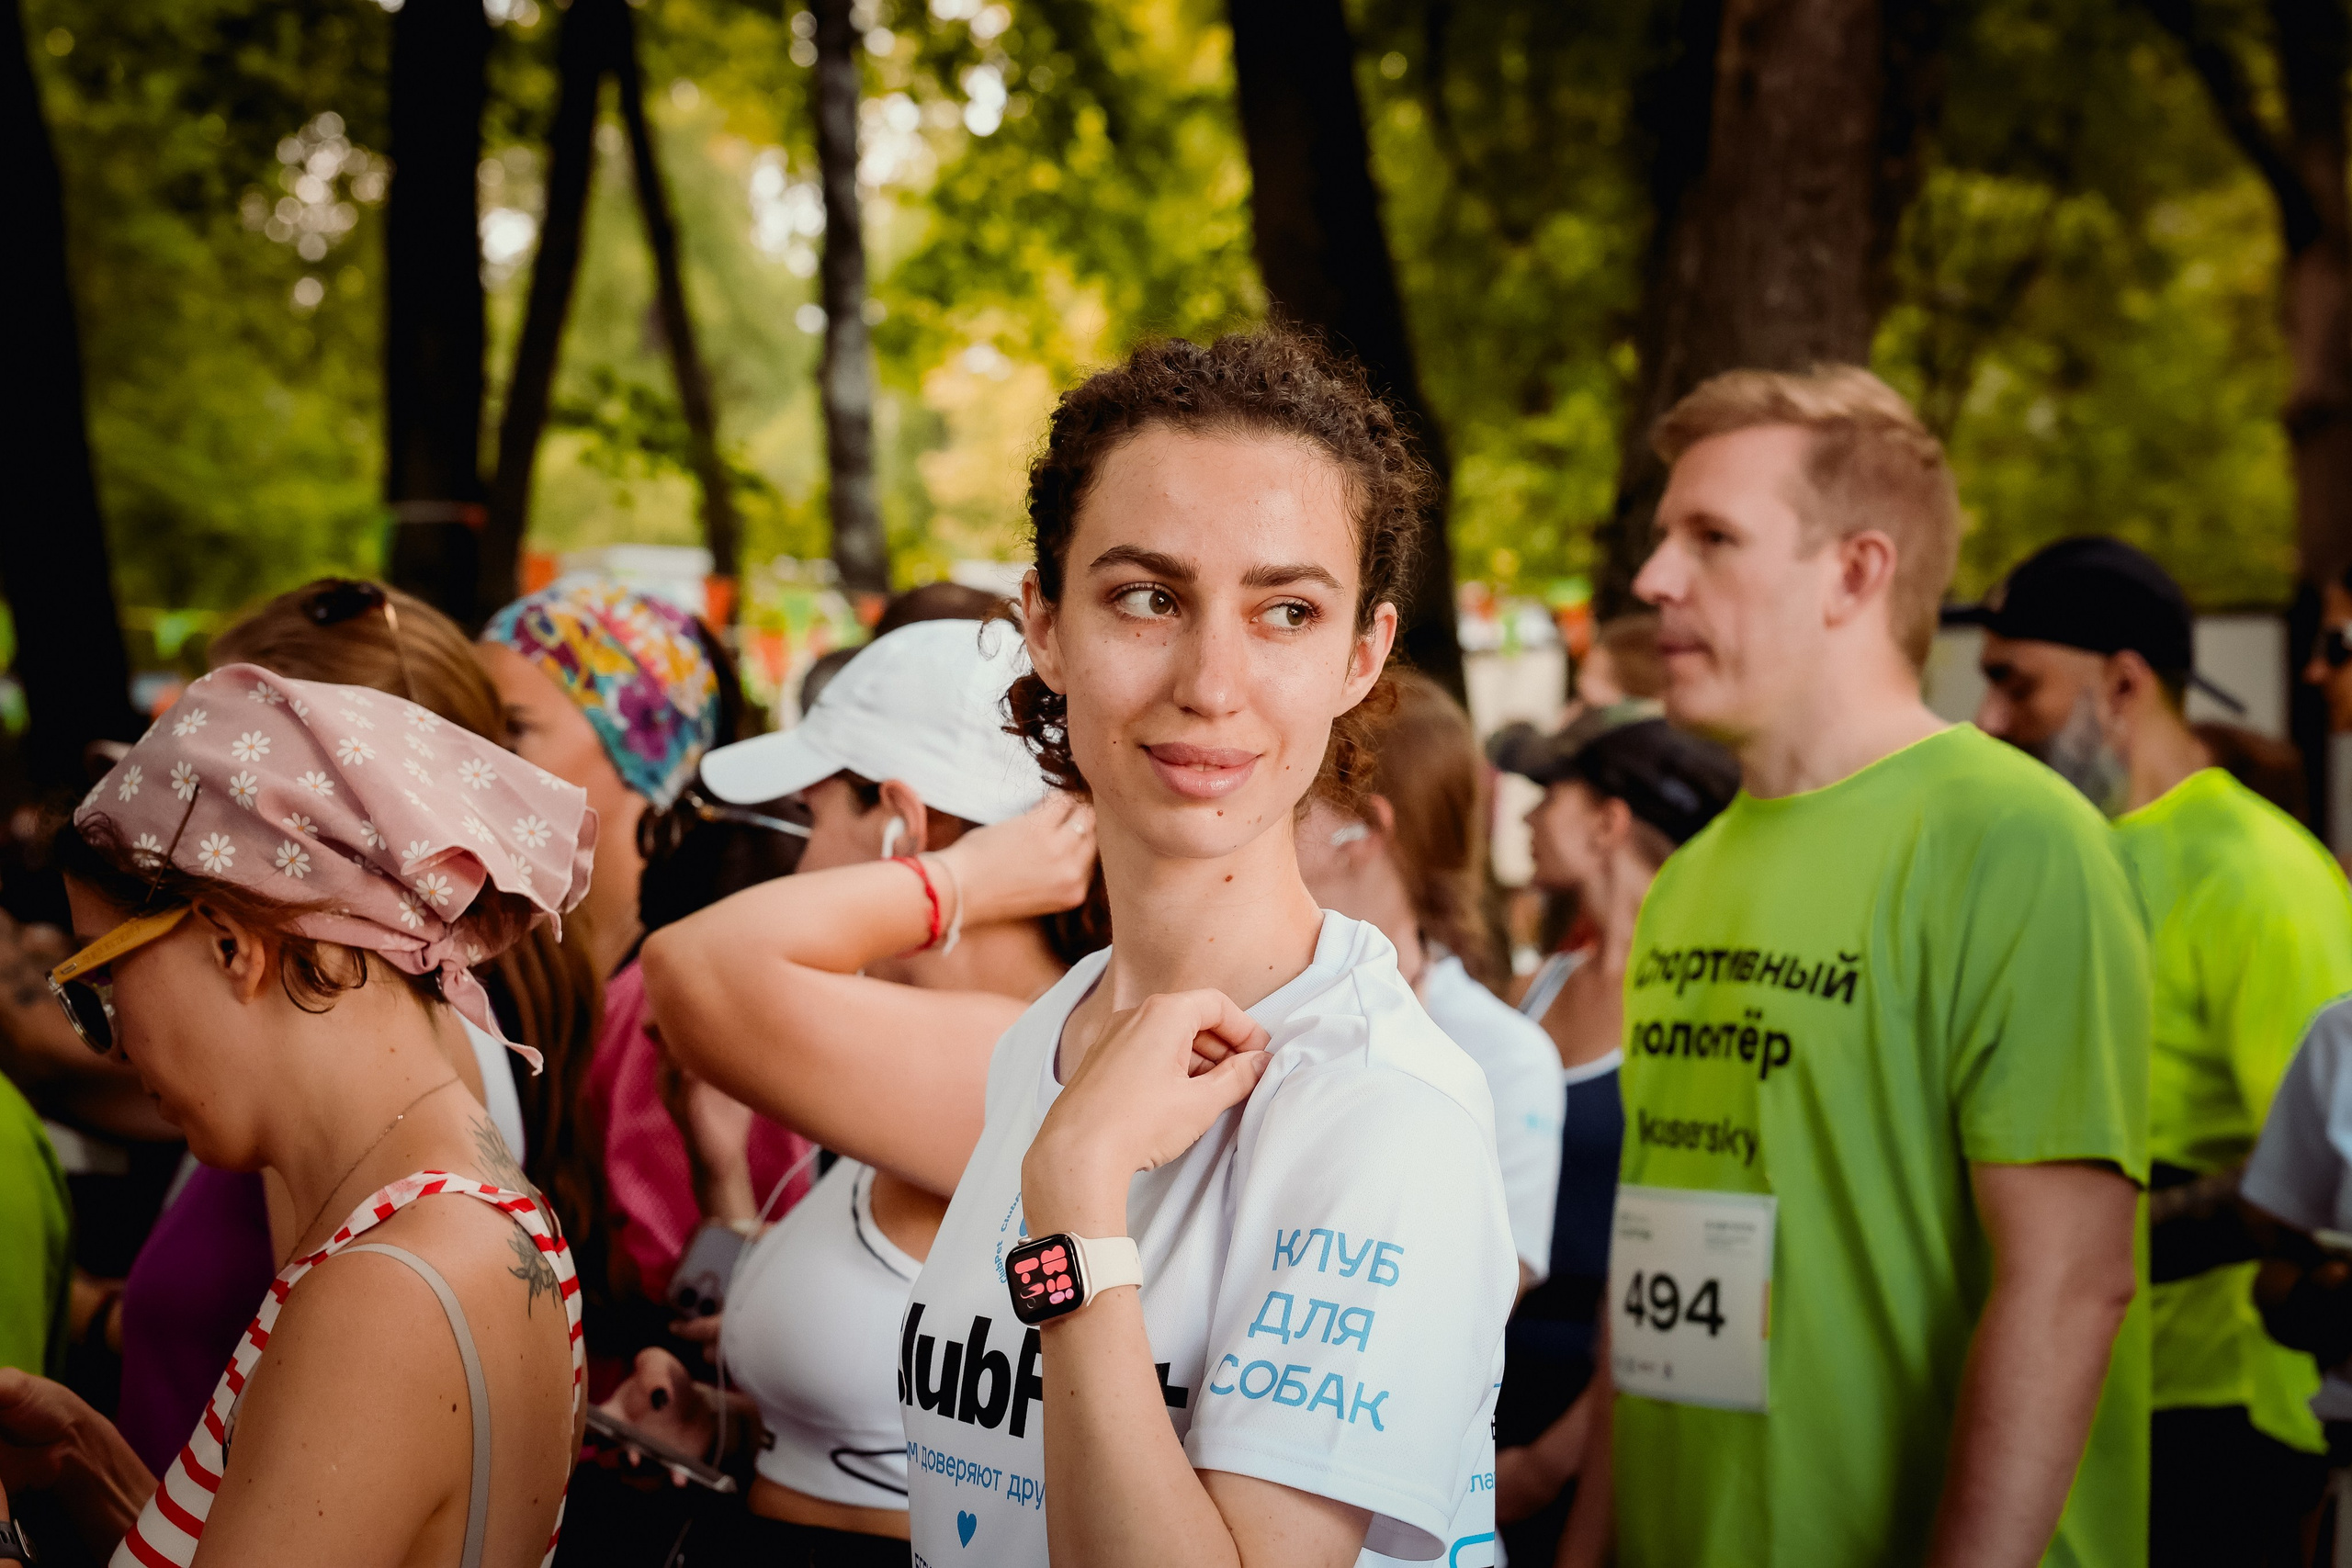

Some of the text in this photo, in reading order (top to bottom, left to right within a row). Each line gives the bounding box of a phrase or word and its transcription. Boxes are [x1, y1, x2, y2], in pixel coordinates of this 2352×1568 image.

[1272, 1227, 1405, 1287] КЛУБ
[1248, 1291, 1375, 1352] ДЛЯ
[1624, 1269, 1725, 1337] 494
[1209, 1353, 1390, 1432] СОБАК
[921, 1445, 1002, 1487] доверяют
